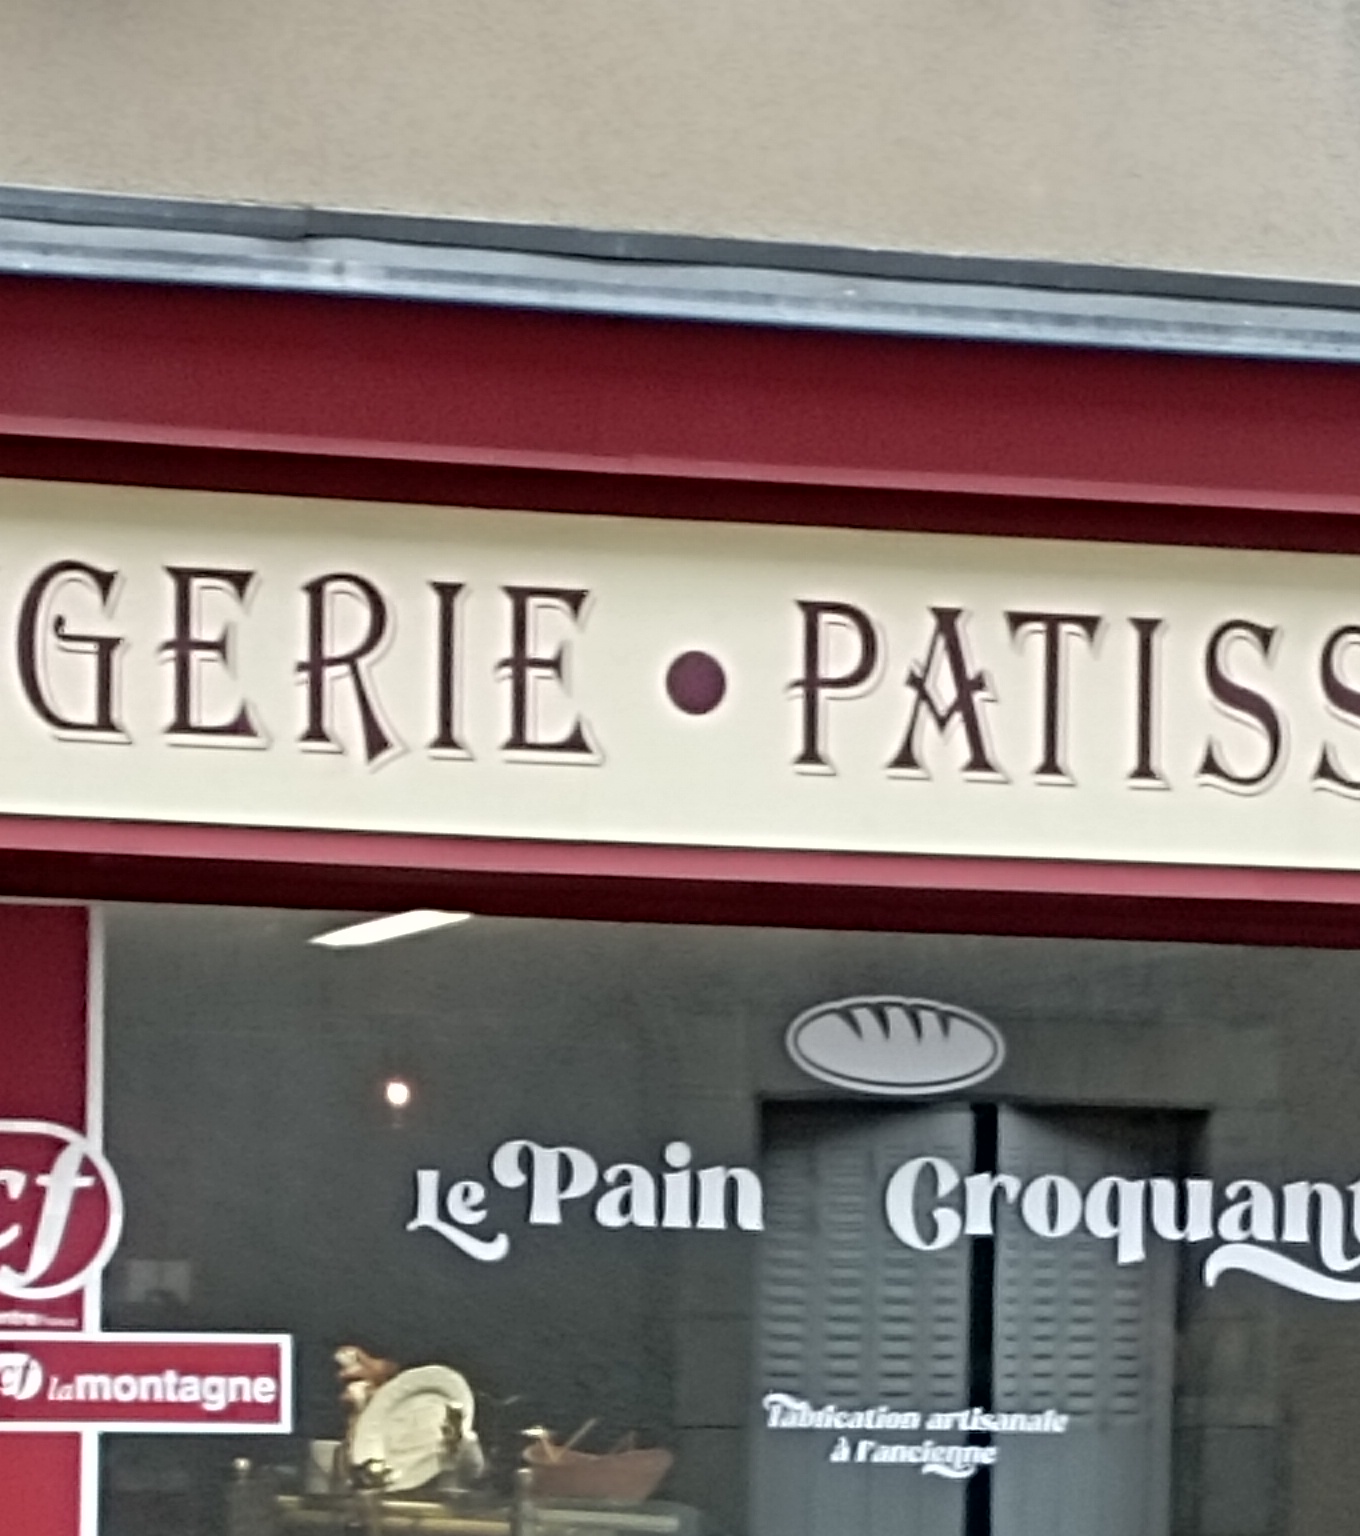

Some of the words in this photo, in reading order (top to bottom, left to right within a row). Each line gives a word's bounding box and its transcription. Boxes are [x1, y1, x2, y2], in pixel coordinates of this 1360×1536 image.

[406, 1167, 510, 1262] Le
[492, 1139, 764, 1231] Pain
[762, 1391, 921, 1429] Fabrication
[925, 1406, 1070, 1433] artisanale
